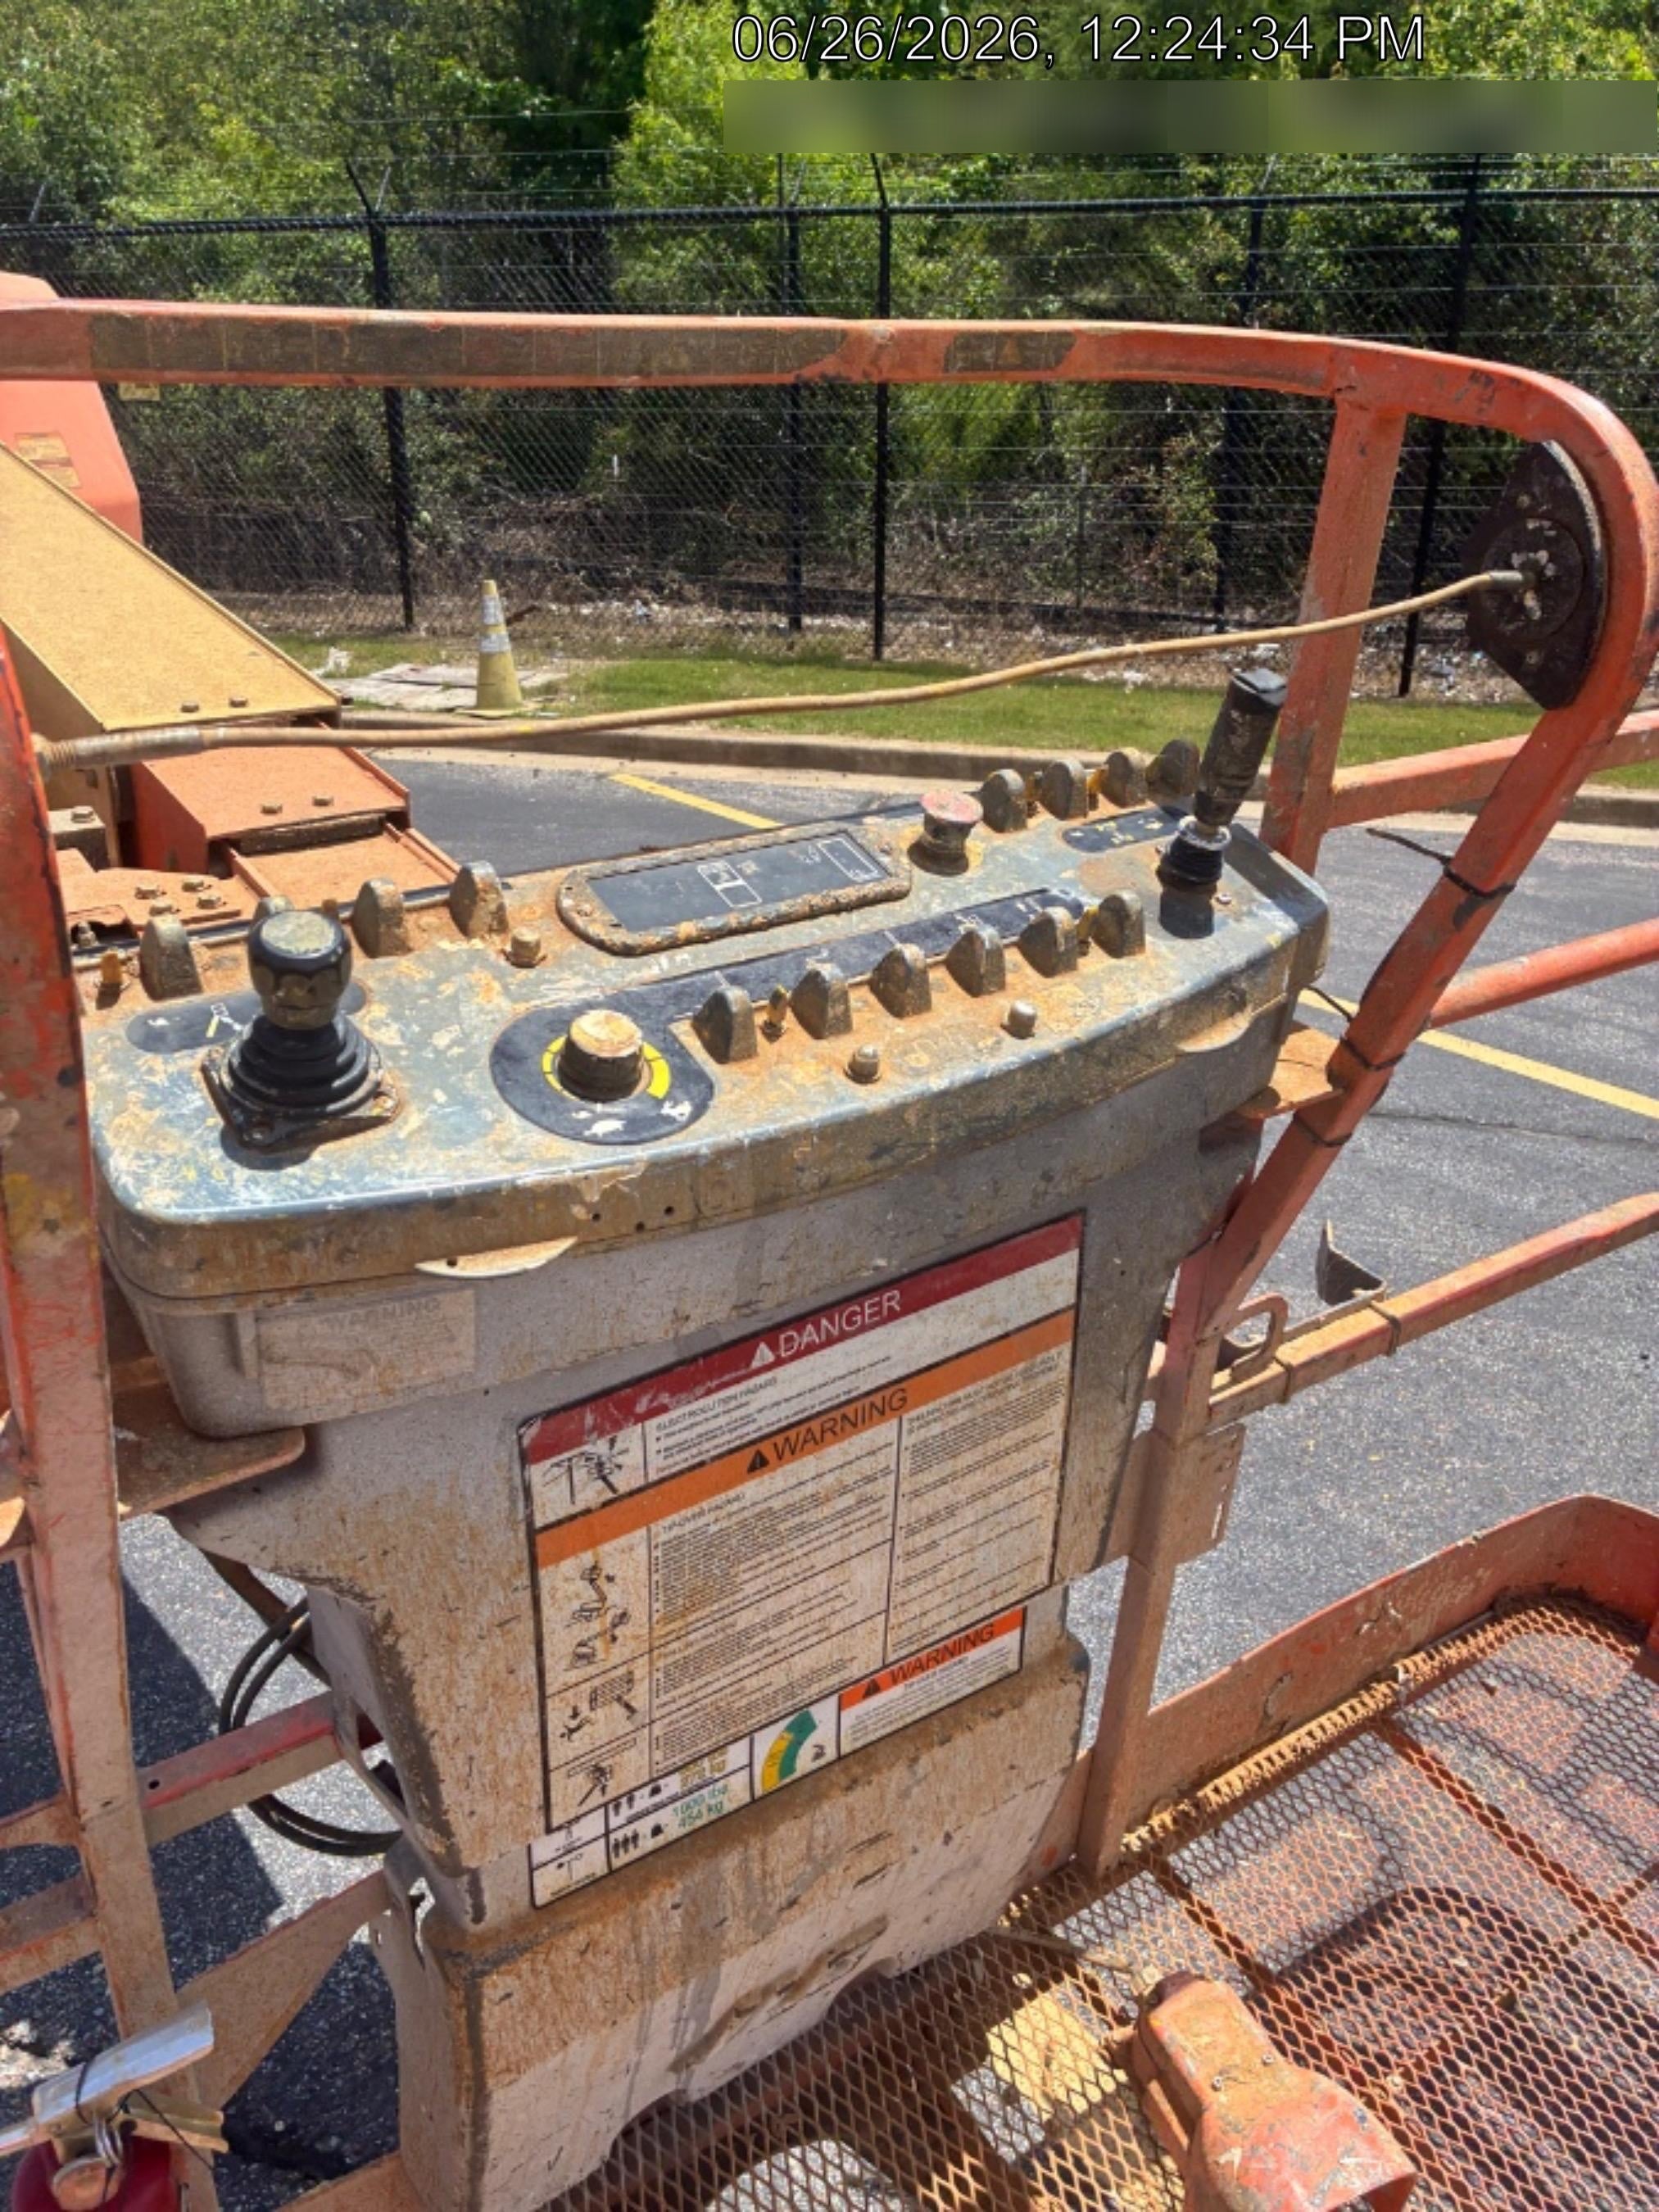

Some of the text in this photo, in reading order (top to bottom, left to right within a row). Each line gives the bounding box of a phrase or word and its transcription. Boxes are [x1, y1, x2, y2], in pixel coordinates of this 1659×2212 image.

[778, 1290, 901, 1358] DANGER
[772, 1388, 908, 1462] WARNING
[891, 1624, 995, 1686] WARNING
